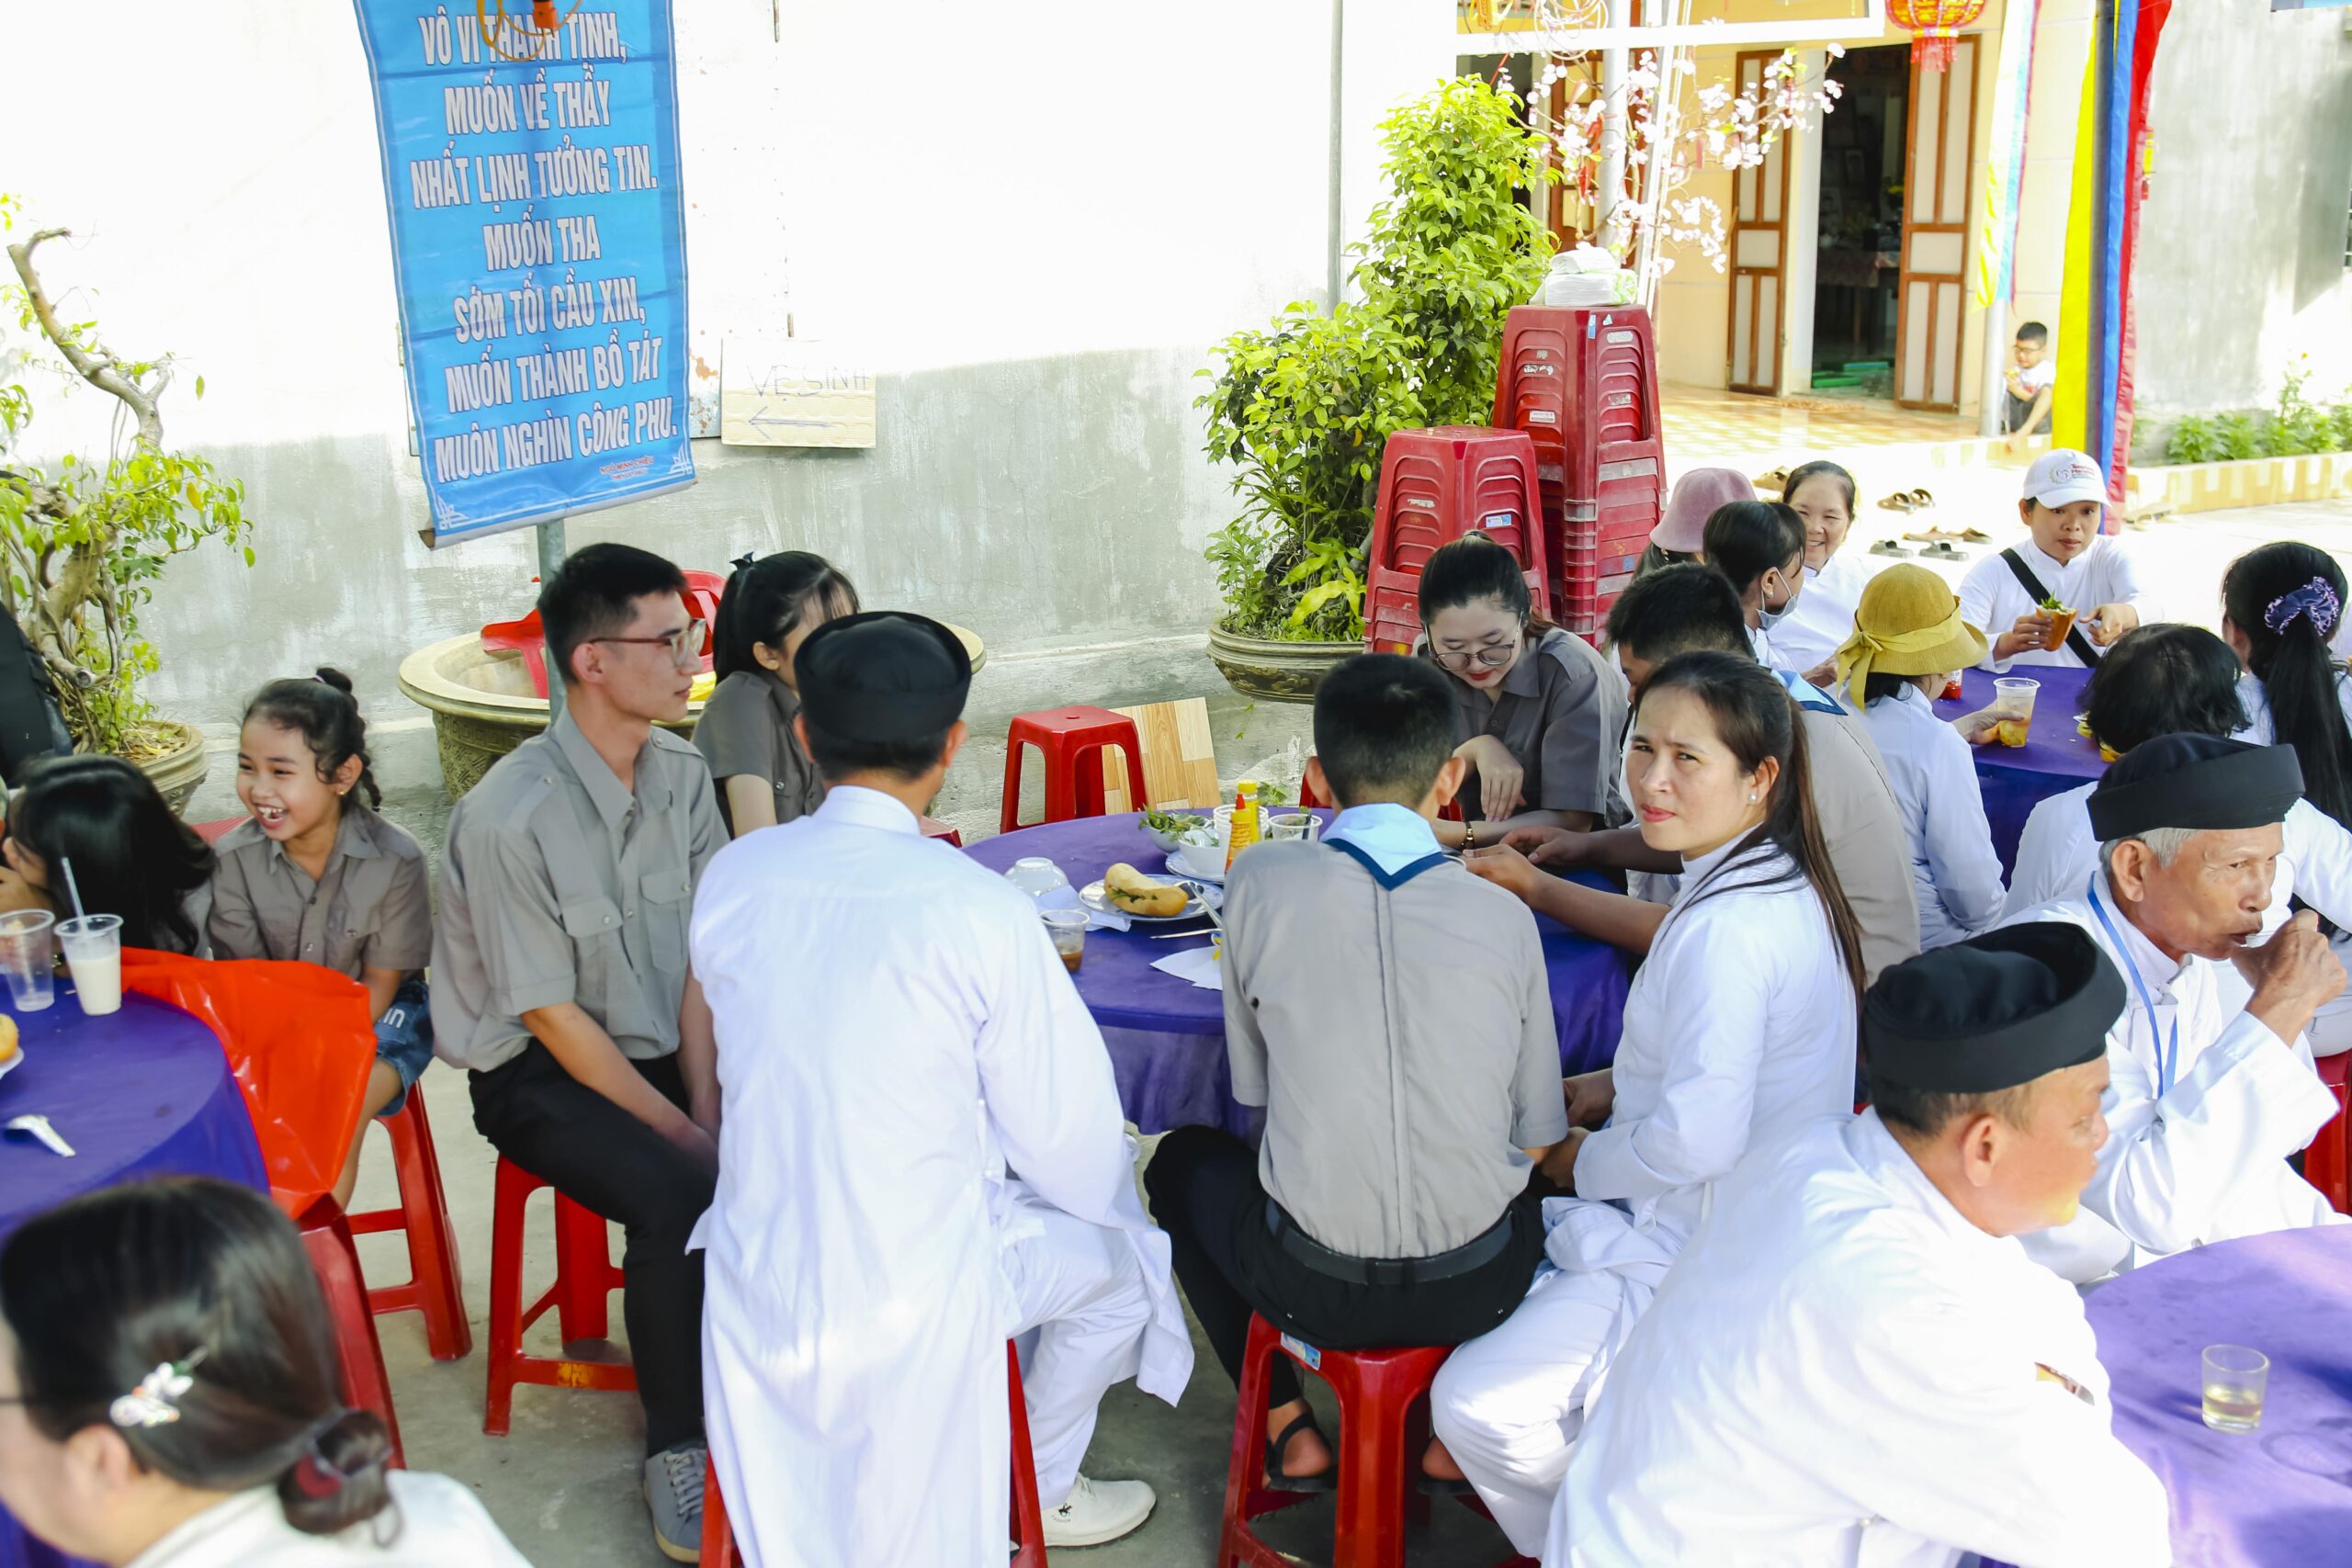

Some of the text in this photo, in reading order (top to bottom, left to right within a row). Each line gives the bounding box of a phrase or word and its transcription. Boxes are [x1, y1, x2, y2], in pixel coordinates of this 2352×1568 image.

[418, 6, 453, 65] VÔ
[457, 15, 481, 64] VI
[483, 14, 561, 62] THANH
[444, 64, 611, 135] MUỐN VỀ THẦY
[410, 134, 658, 213] NHẤT LỊNH TƯỞNG TIN.
[482, 204, 601, 271] MUỐN THA
[453, 267, 646, 344] SỚM TỐI CẦU XIN,
[445, 328, 662, 413] MUỐN THÀNH BỒ TÁT
[435, 396, 678, 484] MUÔN NGHÌN CÔNG PHU.
